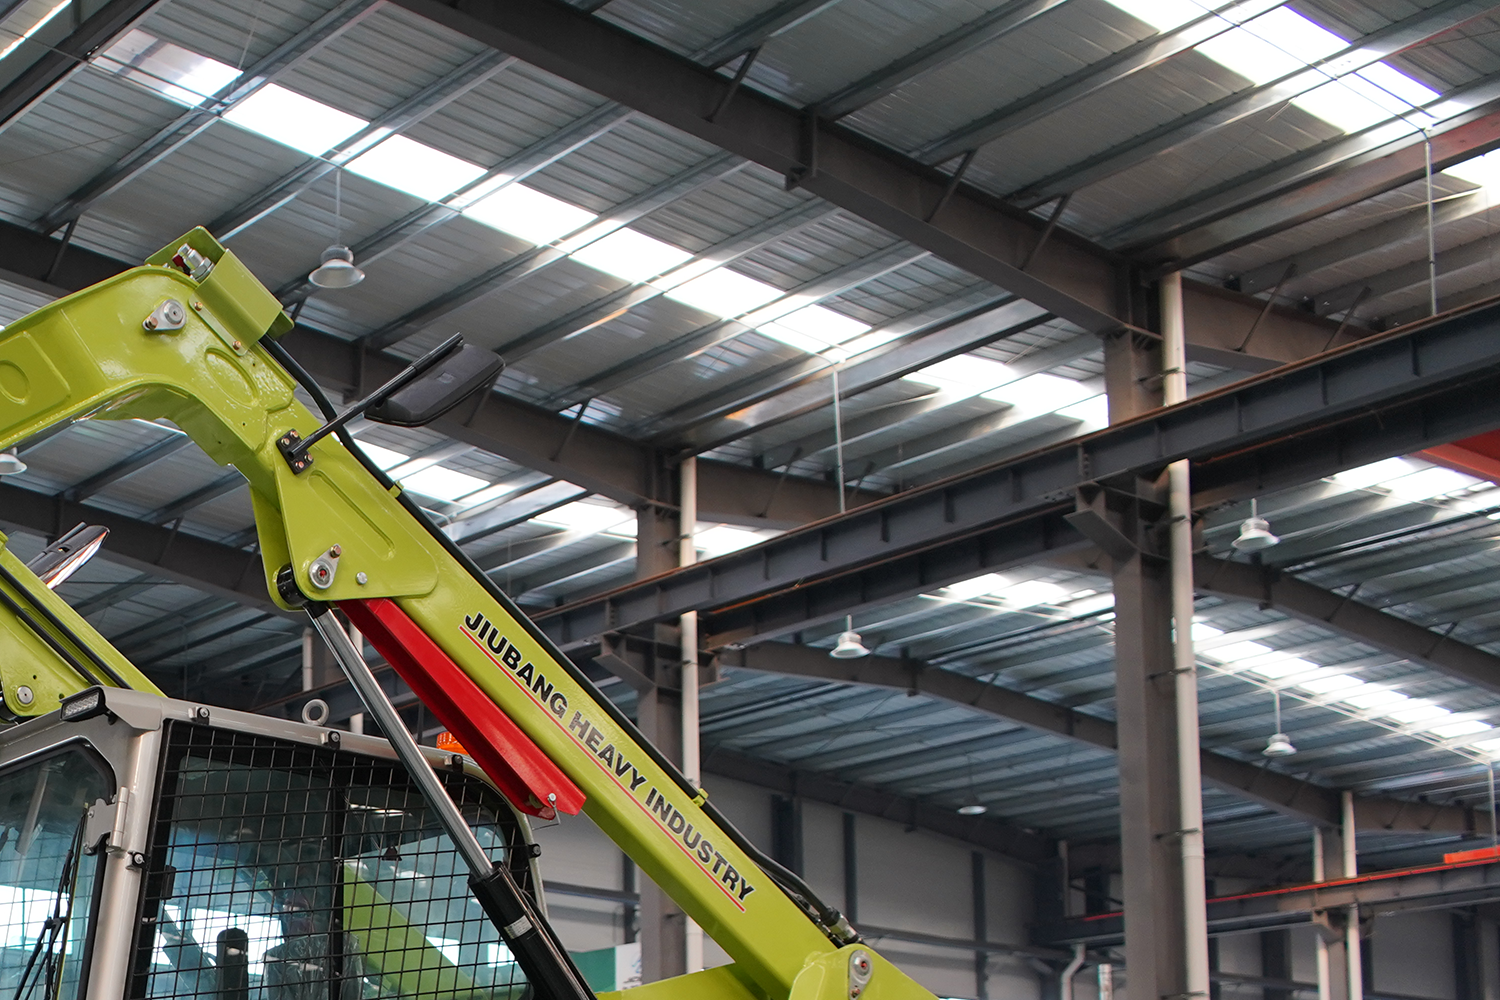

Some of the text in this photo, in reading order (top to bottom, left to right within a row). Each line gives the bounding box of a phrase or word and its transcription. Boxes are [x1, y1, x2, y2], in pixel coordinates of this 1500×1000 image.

[465, 612, 755, 901] JIUBANG HEAVY INDUSTRY
